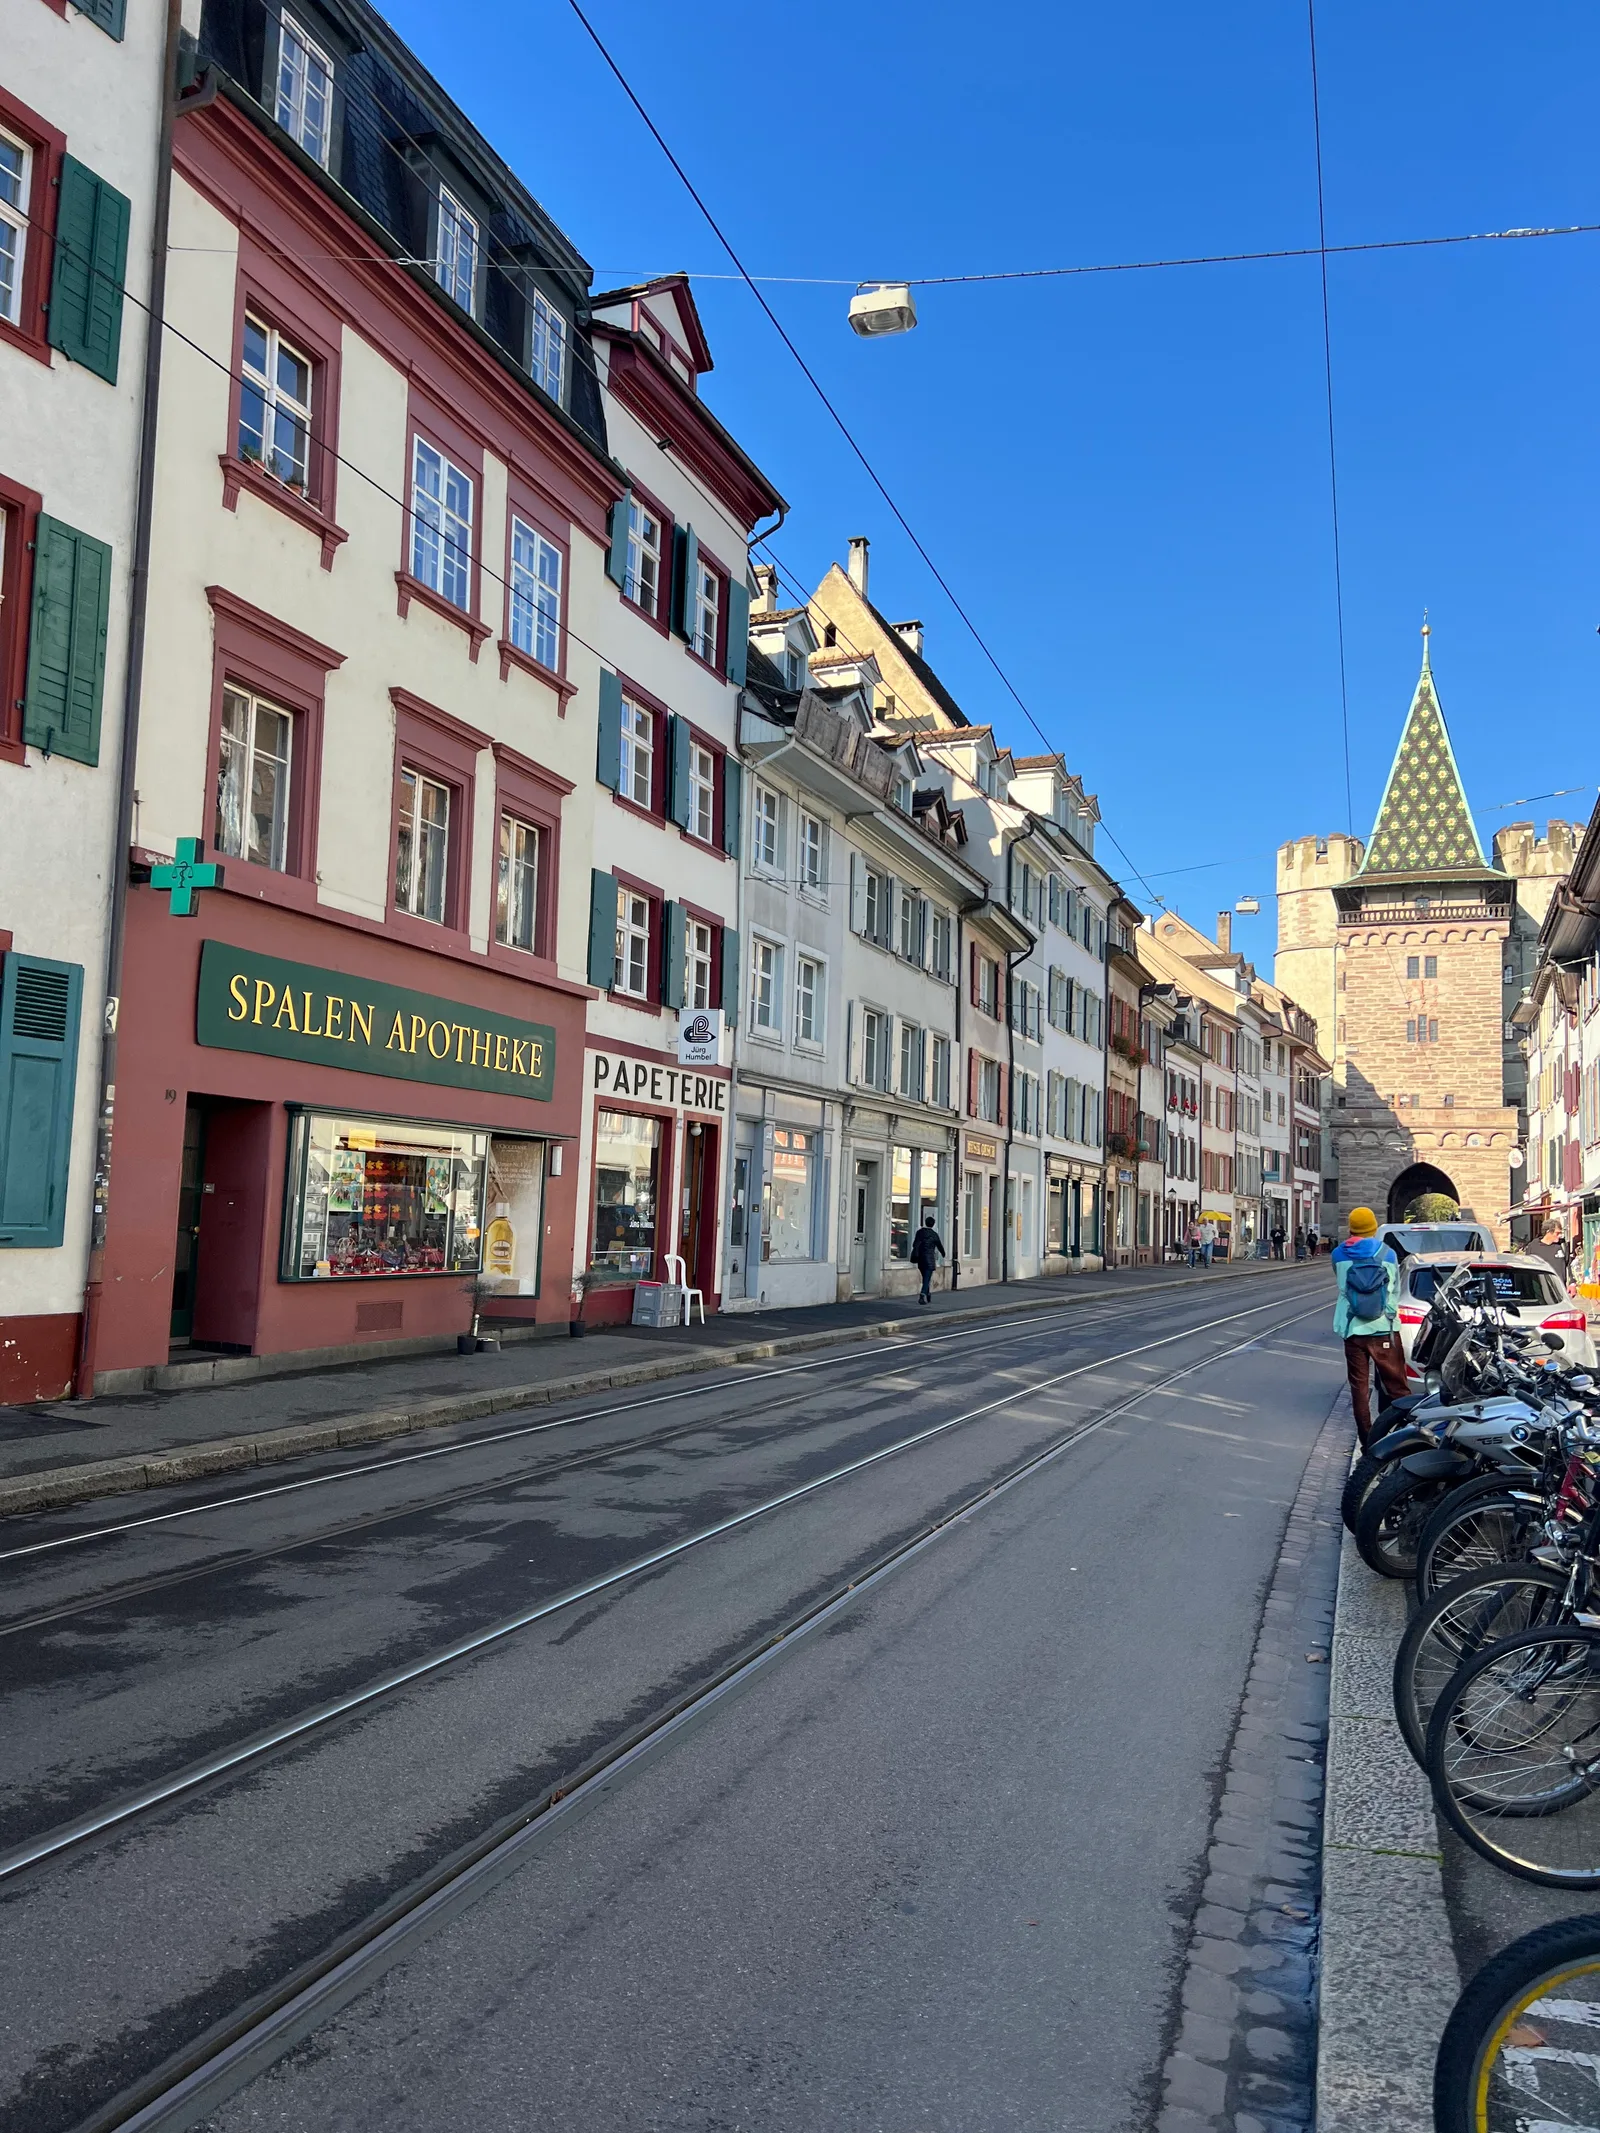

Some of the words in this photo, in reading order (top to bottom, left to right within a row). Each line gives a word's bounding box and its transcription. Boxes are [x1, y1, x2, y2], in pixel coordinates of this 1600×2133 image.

[227, 973, 375, 1046] SPALEN
[385, 1010, 544, 1079] APOTHEKE
[685, 1053, 712, 1061] Humbel
[691, 1046, 707, 1055] Jürg
[594, 1054, 726, 1112] PAPETERIE
[164, 1088, 177, 1105] 19
